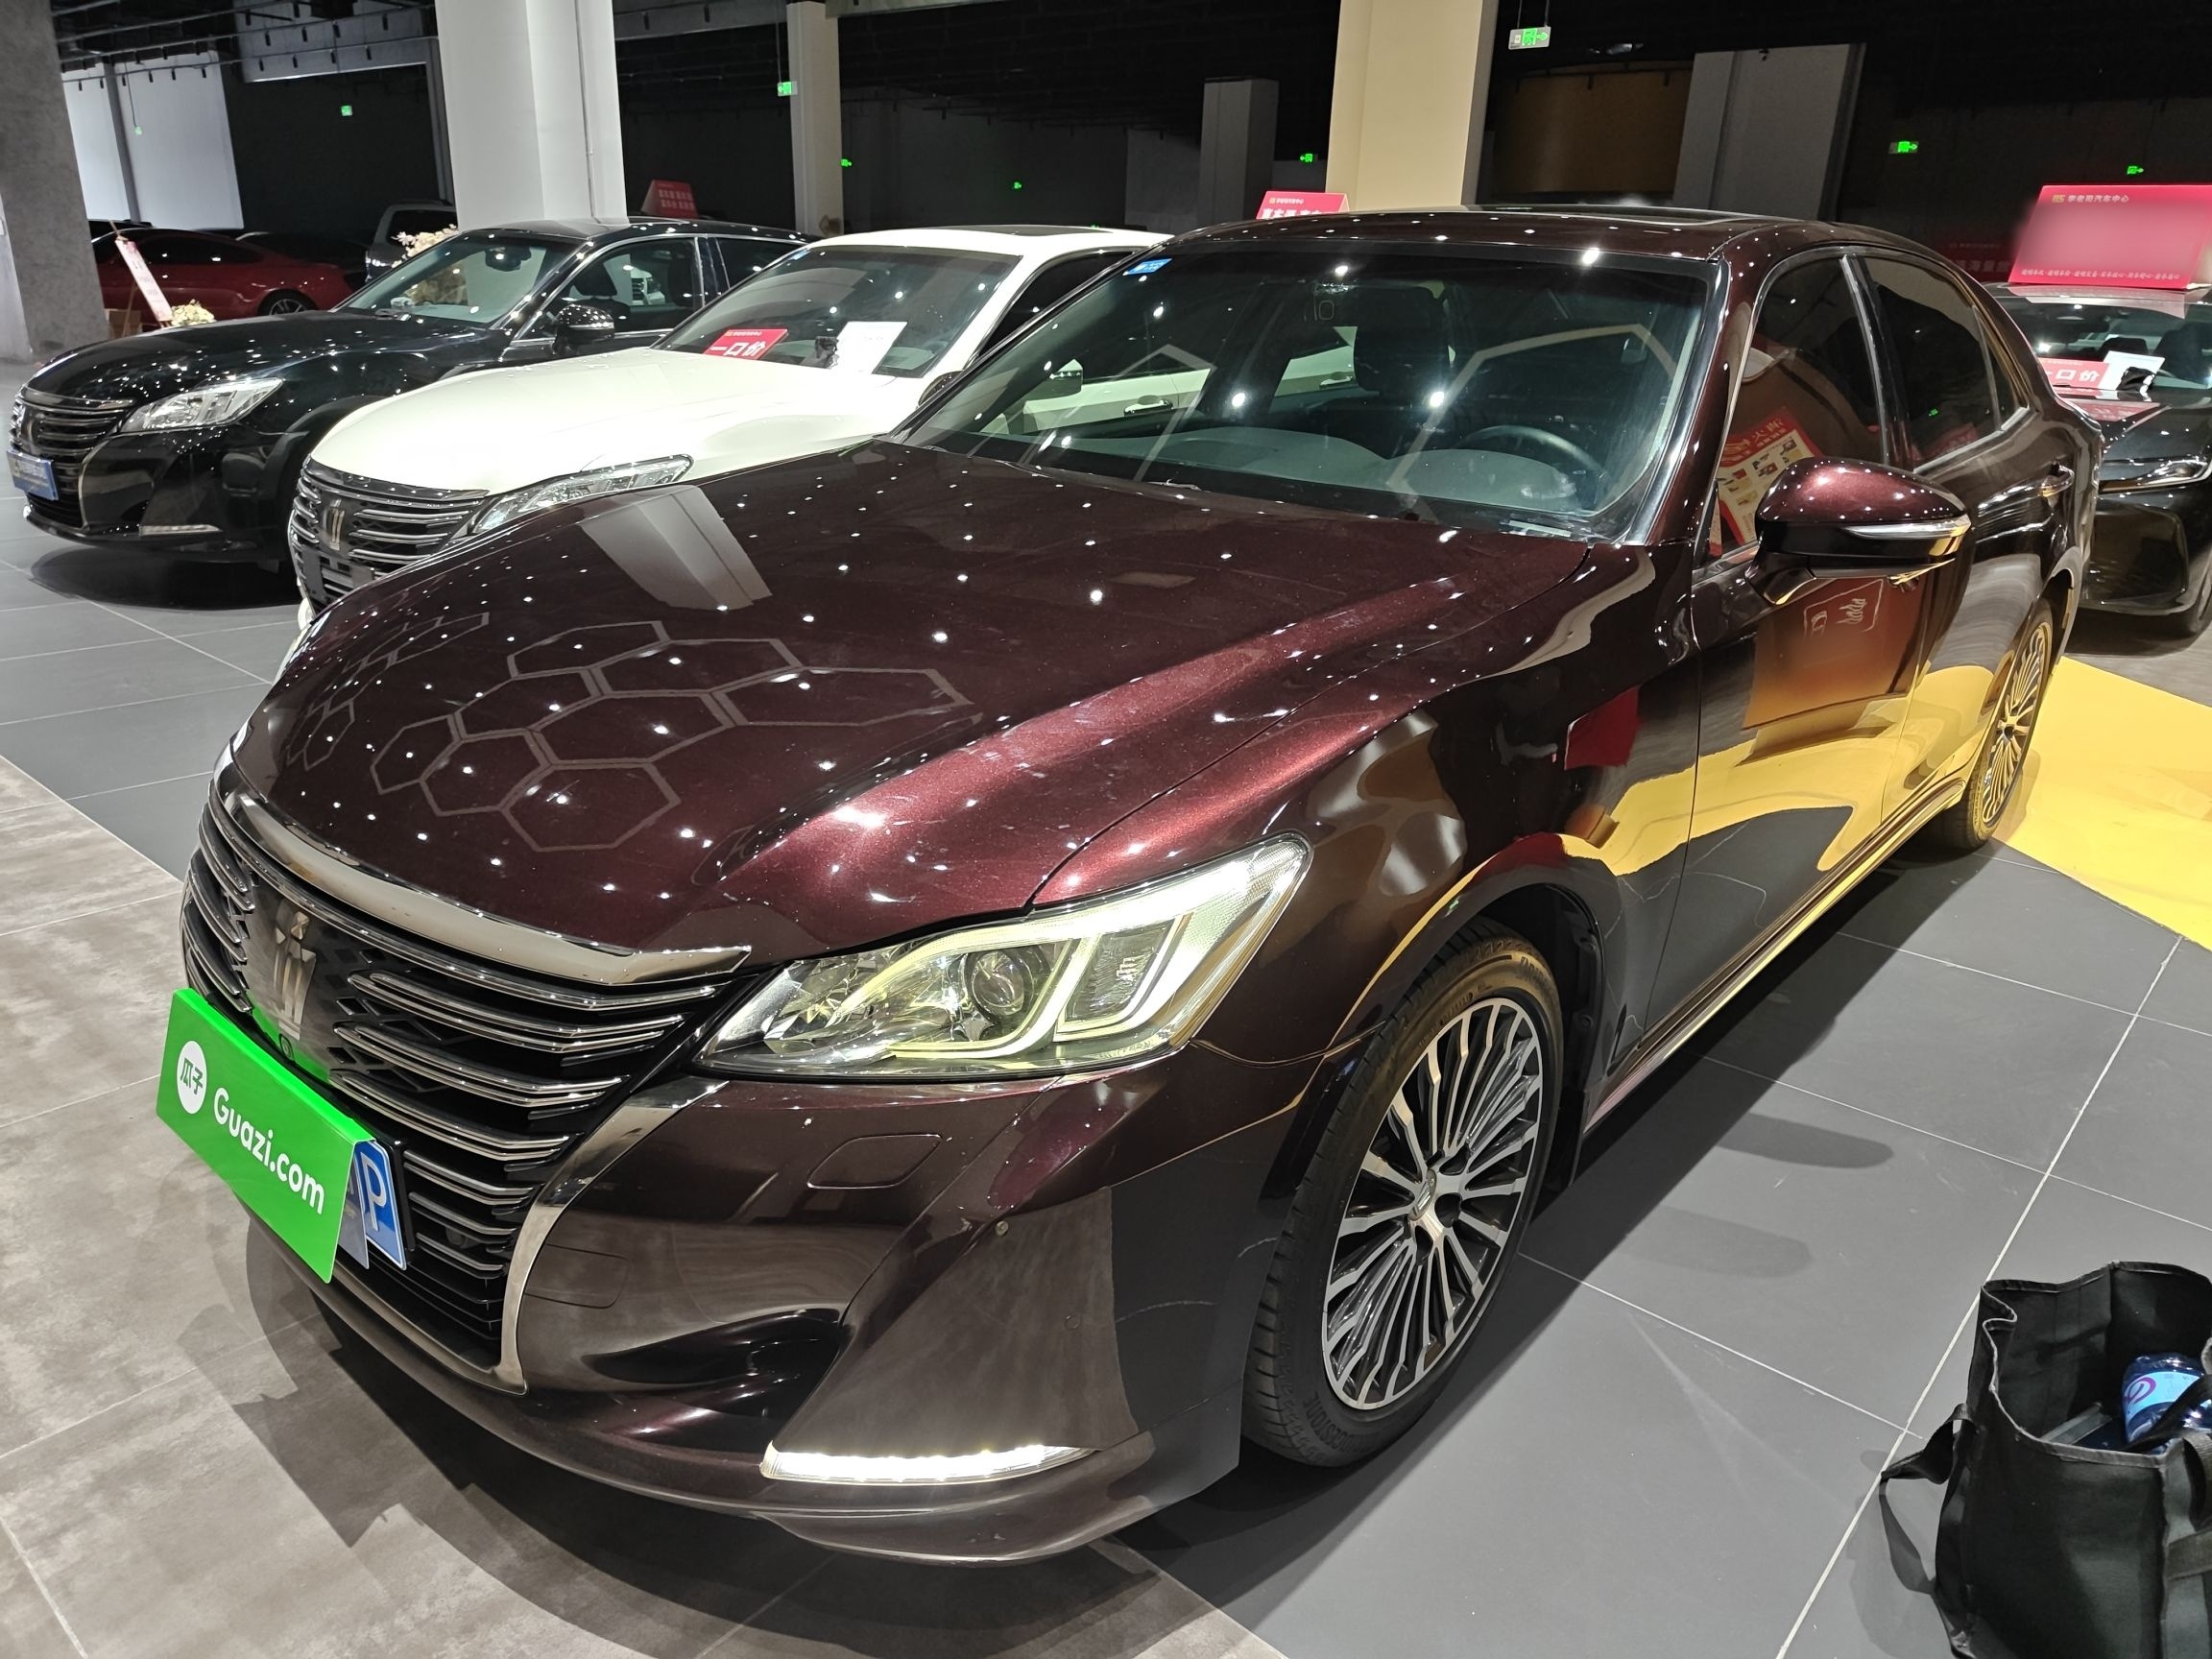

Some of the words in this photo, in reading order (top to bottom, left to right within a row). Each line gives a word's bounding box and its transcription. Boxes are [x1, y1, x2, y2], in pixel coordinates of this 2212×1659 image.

[710, 341, 766, 357] 一口价
[180, 1057, 204, 1095] 瓜子
[213, 1087, 325, 1215] Guazi.com
